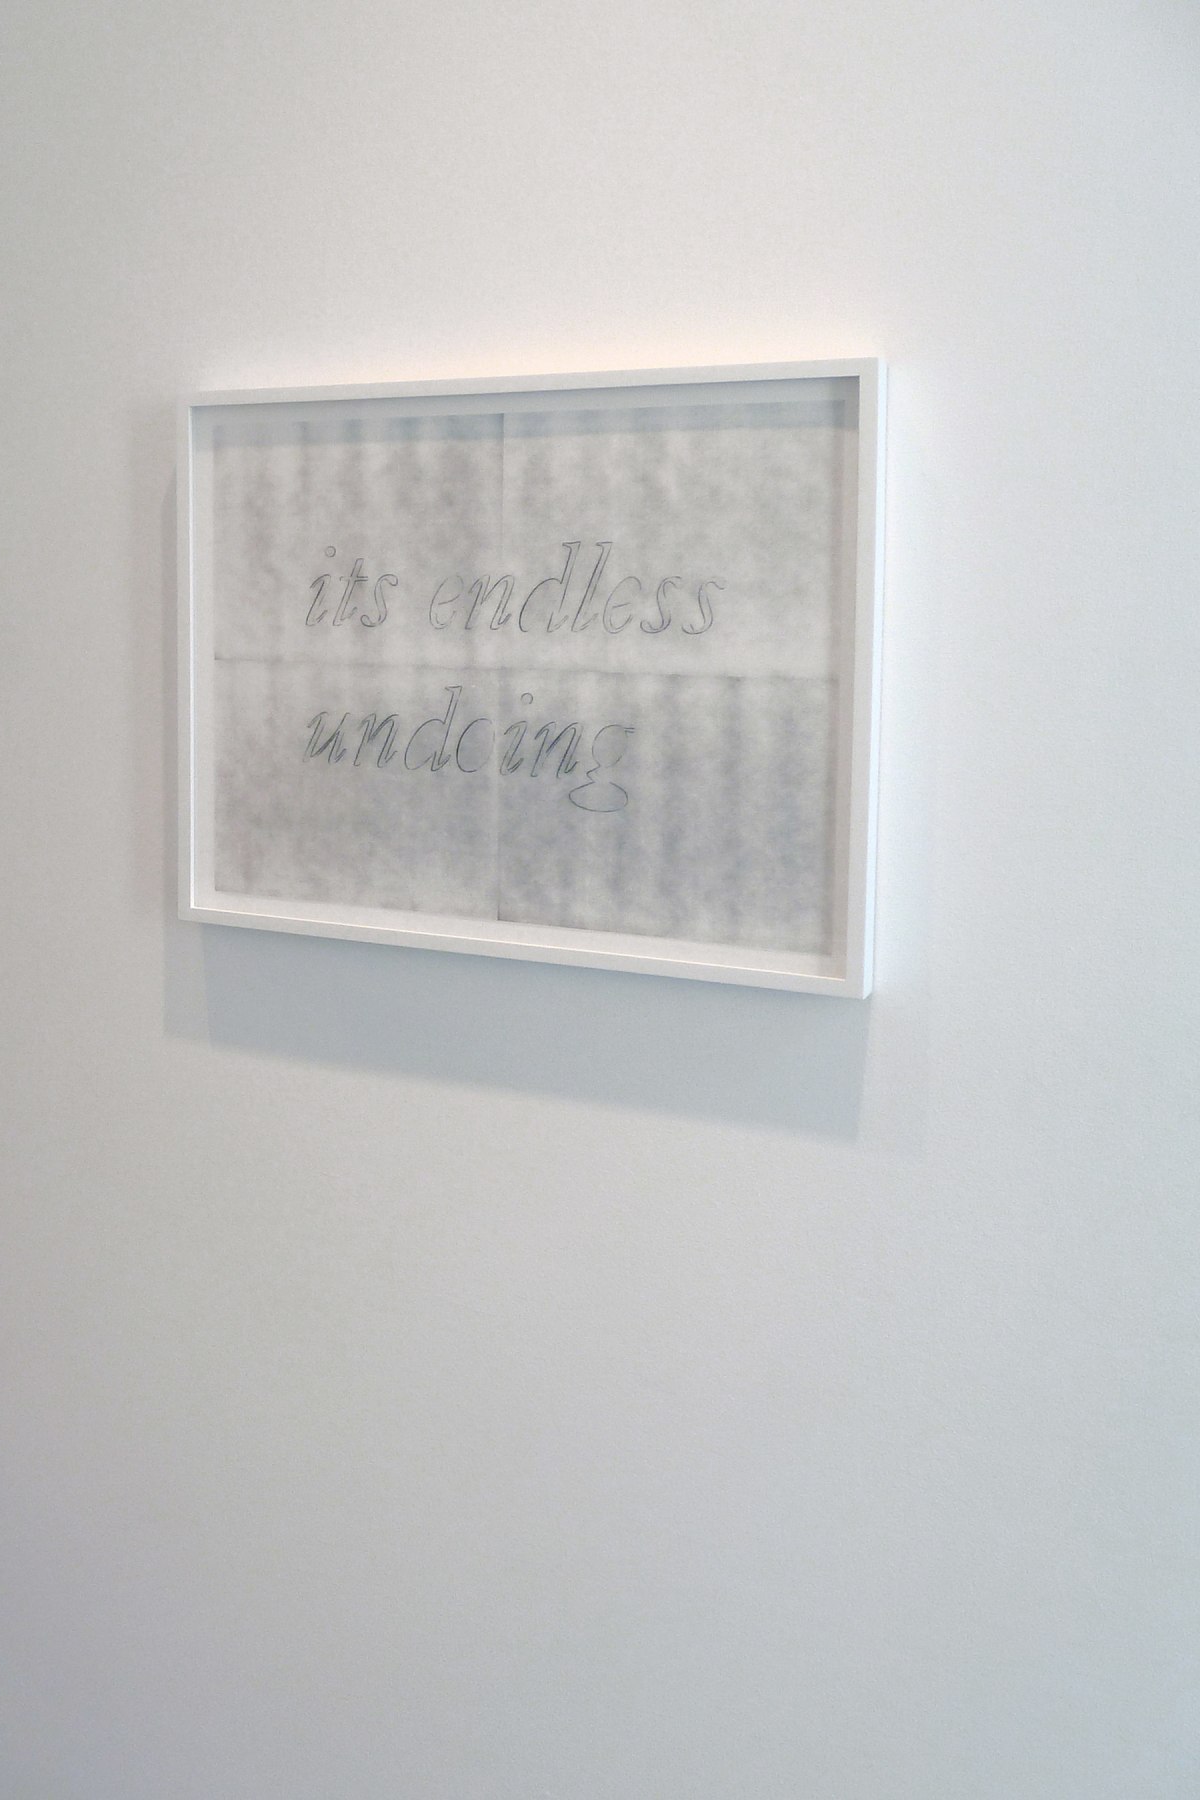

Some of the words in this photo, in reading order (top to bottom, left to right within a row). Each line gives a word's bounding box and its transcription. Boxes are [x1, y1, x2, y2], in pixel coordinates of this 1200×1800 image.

[305, 546, 400, 628] its
[428, 540, 725, 635] endless
[303, 685, 635, 813] undoing
